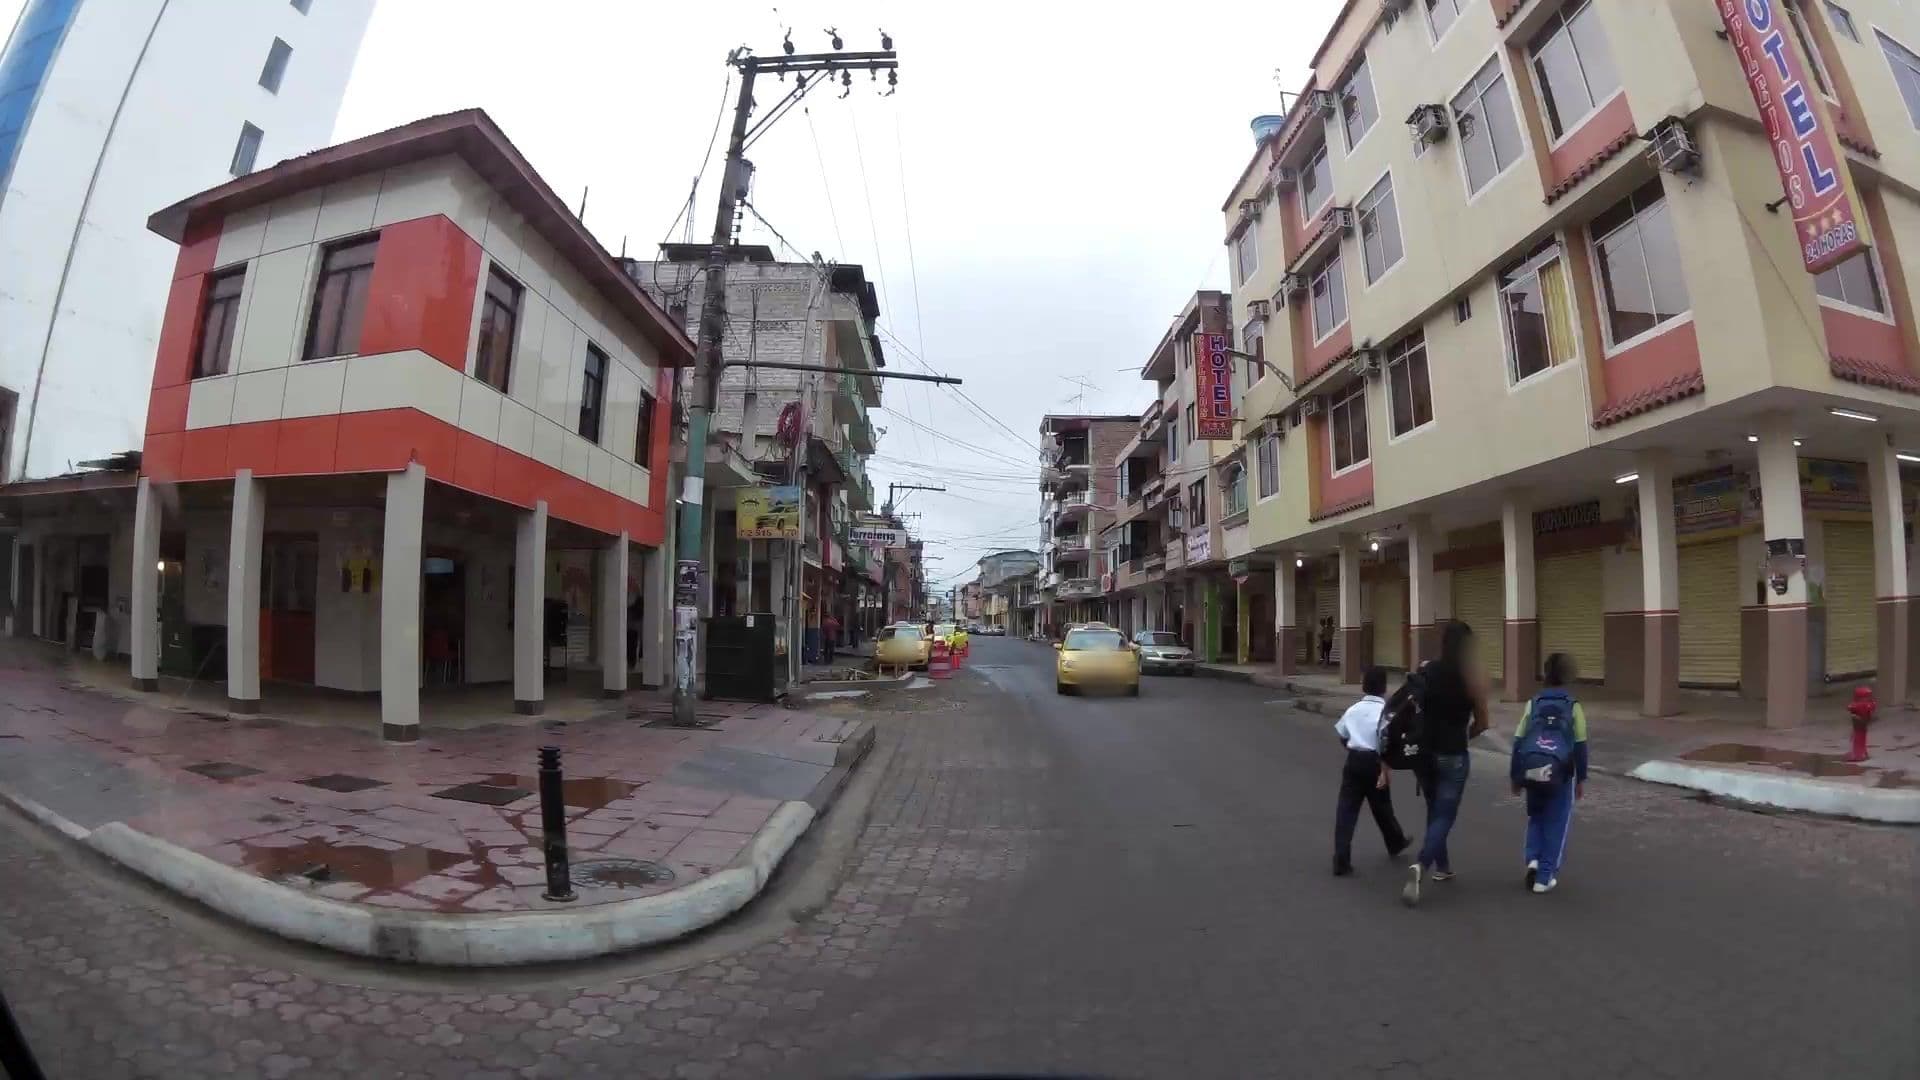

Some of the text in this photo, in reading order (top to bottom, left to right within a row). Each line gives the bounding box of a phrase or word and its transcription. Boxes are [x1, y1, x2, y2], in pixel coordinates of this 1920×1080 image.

[1806, 221, 1857, 263] 24 HORAS
[1210, 335, 1228, 418] HOTEL
